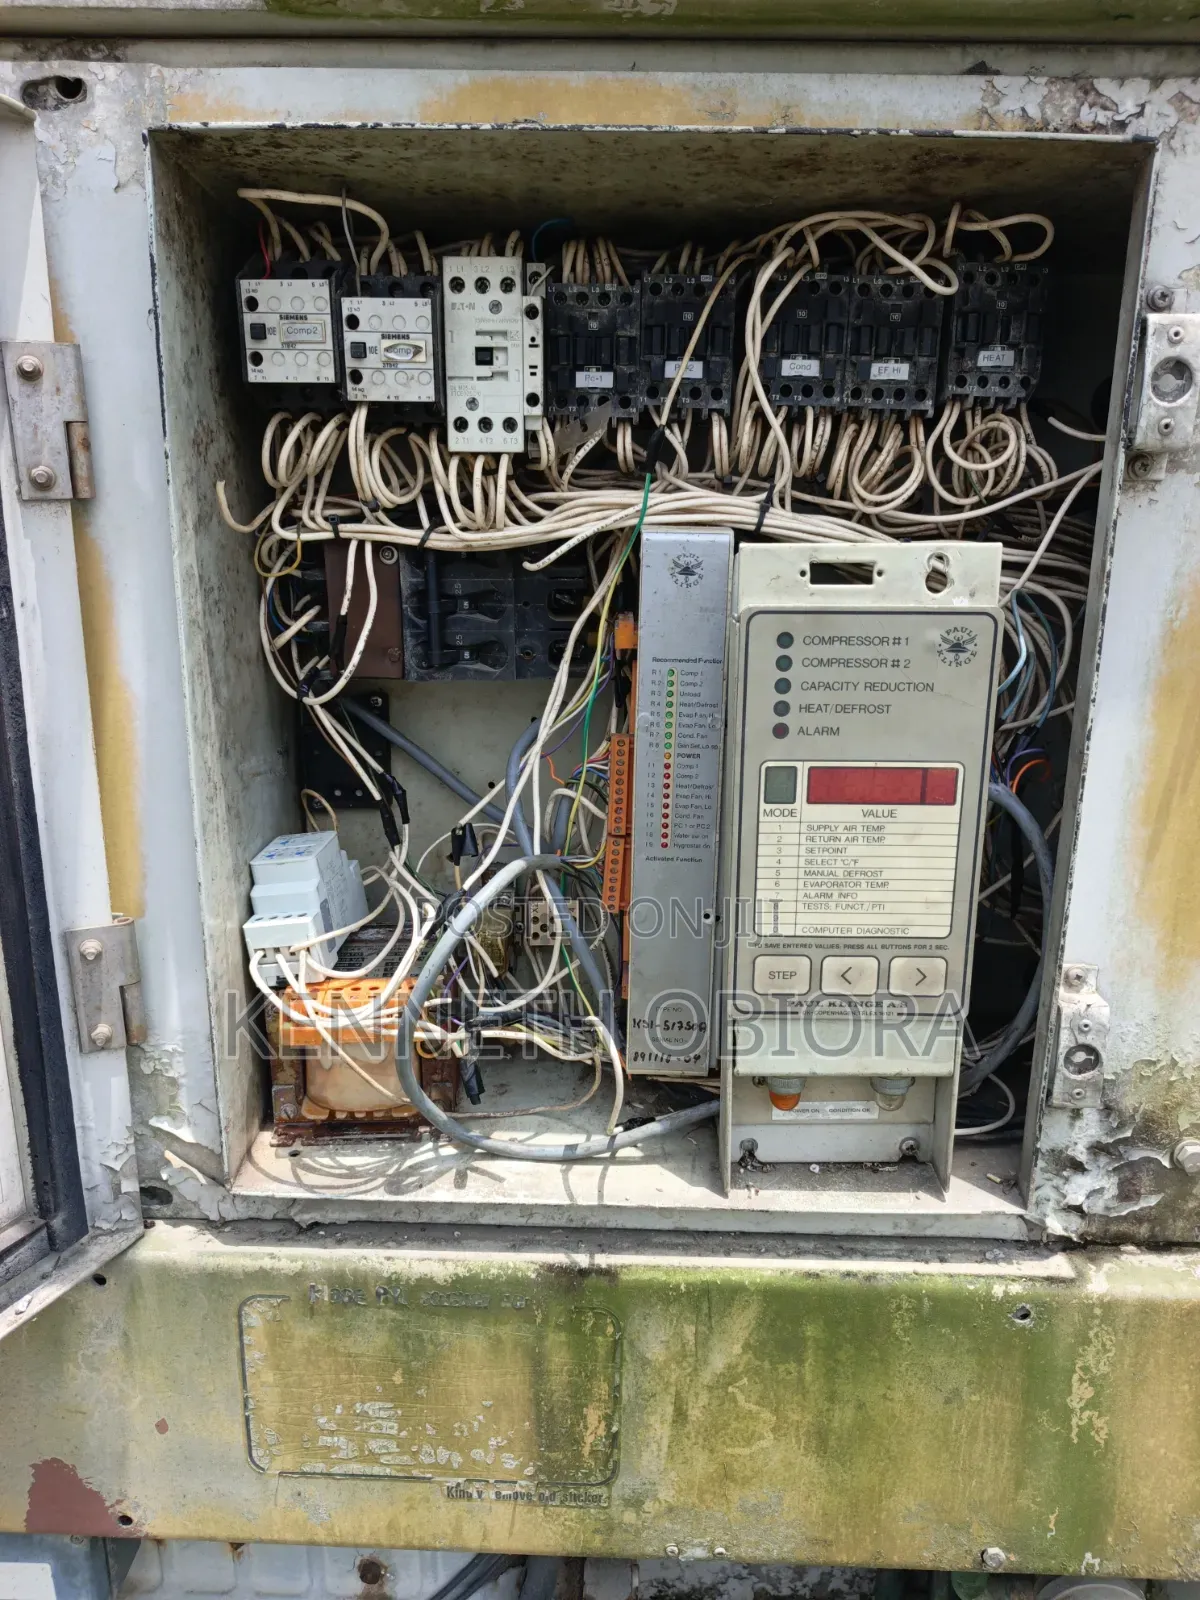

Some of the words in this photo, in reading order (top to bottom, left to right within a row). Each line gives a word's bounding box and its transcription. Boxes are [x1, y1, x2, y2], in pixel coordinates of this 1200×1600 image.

[983, 354, 1006, 362] HEAT
[789, 362, 812, 371] Cond
[944, 626, 974, 637] PAUL
[456, 634, 463, 645] 25
[803, 636, 890, 647] COMPRESSOR
[652, 656, 698, 664] Recommended
[936, 649, 979, 668] KLINGE
[801, 658, 888, 669] COMPRESSOR
[904, 659, 911, 669] 2
[800, 681, 860, 692] CAPACITY
[864, 682, 934, 693] REDUCTION
[799, 704, 892, 715] HEAT/DEFROST
[797, 727, 840, 737] ALARM
[763, 808, 798, 818] MODE
[862, 809, 898, 819] VALUE
[805, 836, 842, 844] RETURN
[844, 836, 860, 844] AIR
[862, 836, 886, 844] TEMP.
[805, 847, 848, 855] SETPOINT
[776, 858, 782, 866] 4
[804, 858, 838, 866] SELECT
[804, 870, 839, 878] MANUAL
[842, 870, 884, 878] DEFROST
[775, 880, 781, 888] 6
[803, 880, 862, 889] EVAPORATOR
[865, 881, 890, 889] TEMP.
[802, 892, 834, 900] ALARM
[838, 892, 858, 900] INFO
[802, 903, 832, 911] TESTS:
[802, 927, 853, 935] COMPUTER
[856, 927, 910, 936] DIAGNOSTIC
[768, 971, 797, 980] STEP
